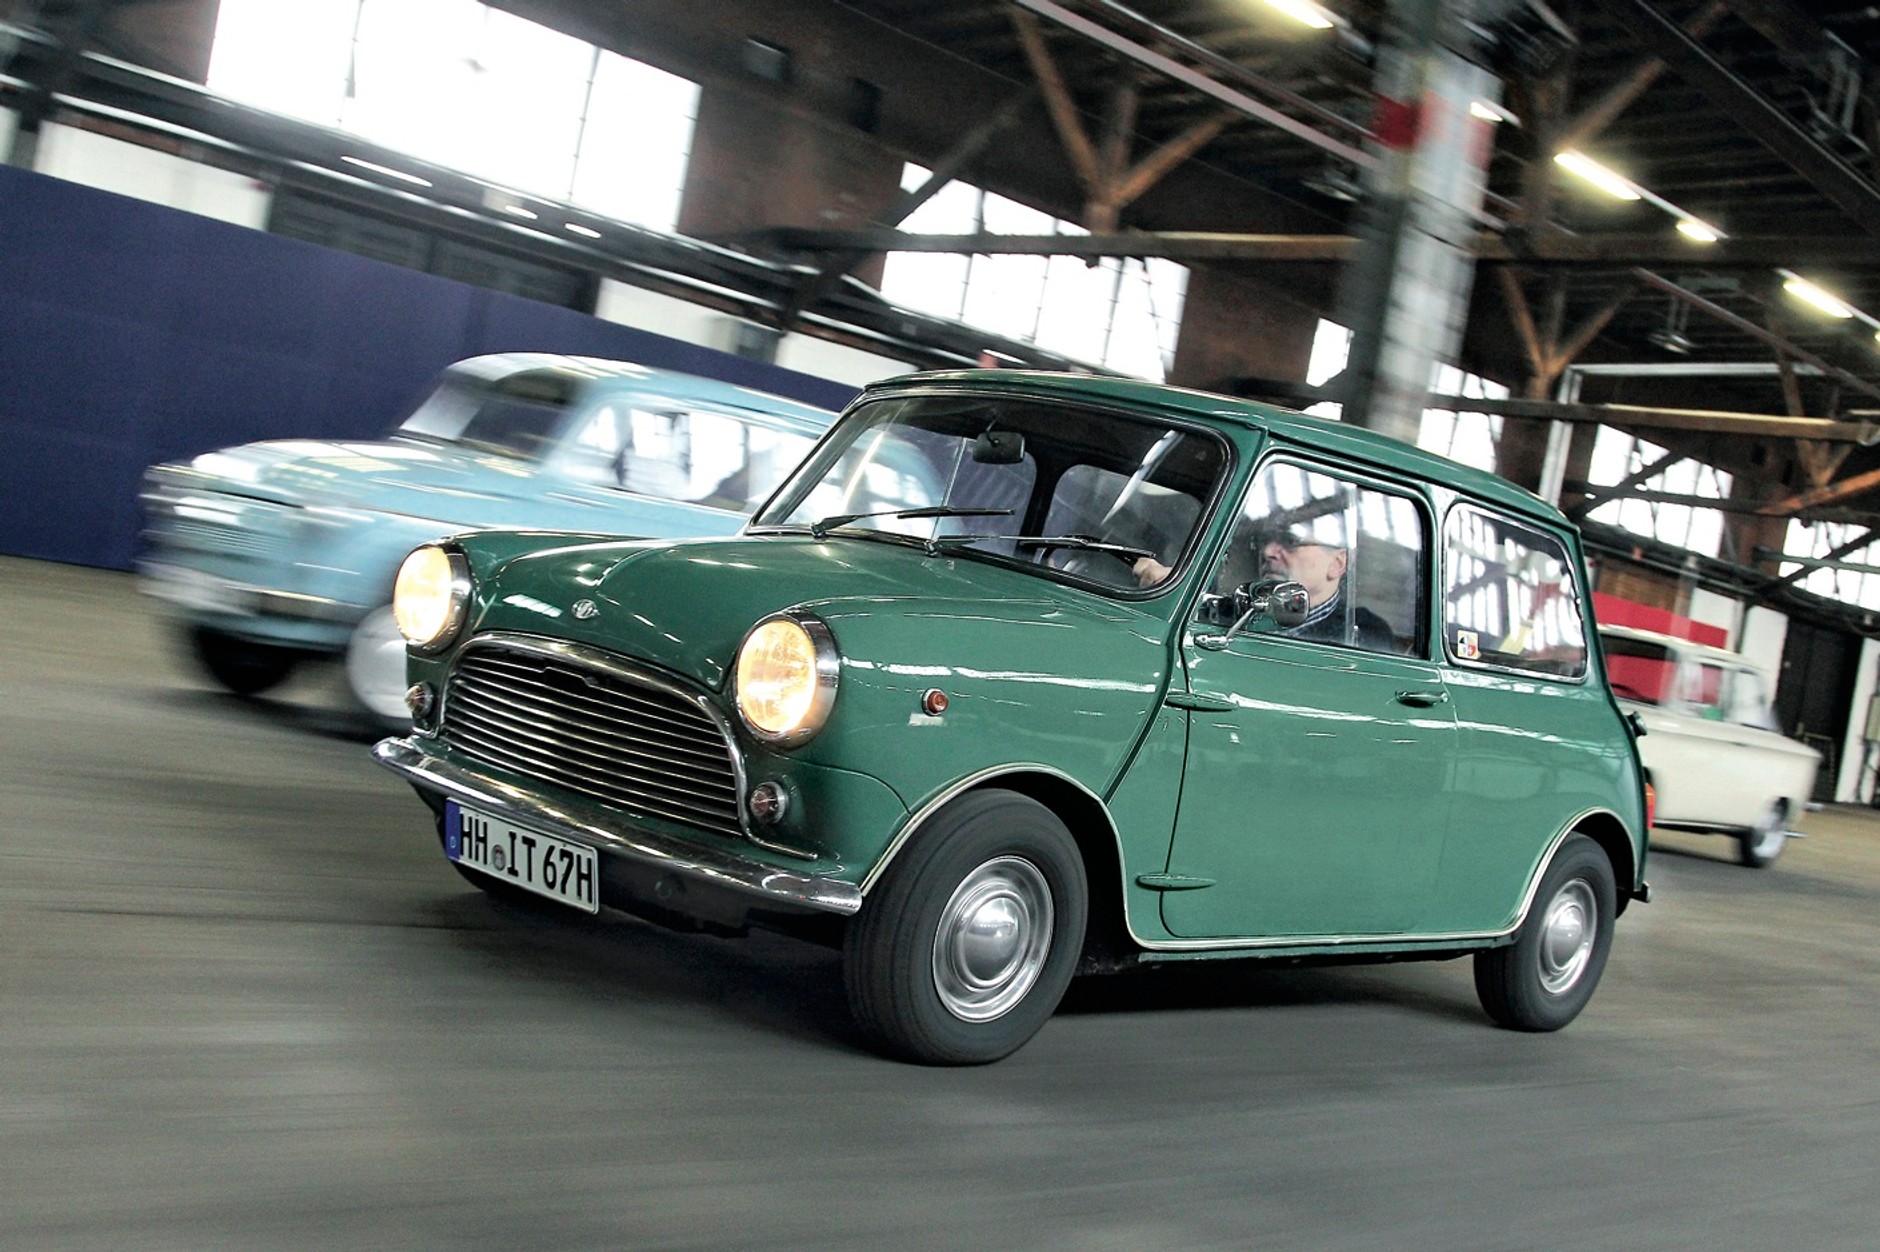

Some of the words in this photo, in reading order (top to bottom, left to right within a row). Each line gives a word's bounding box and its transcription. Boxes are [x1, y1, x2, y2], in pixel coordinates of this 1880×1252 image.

[460, 813, 488, 865] HH
[507, 831, 537, 883] IT
[543, 845, 593, 904] 67H
